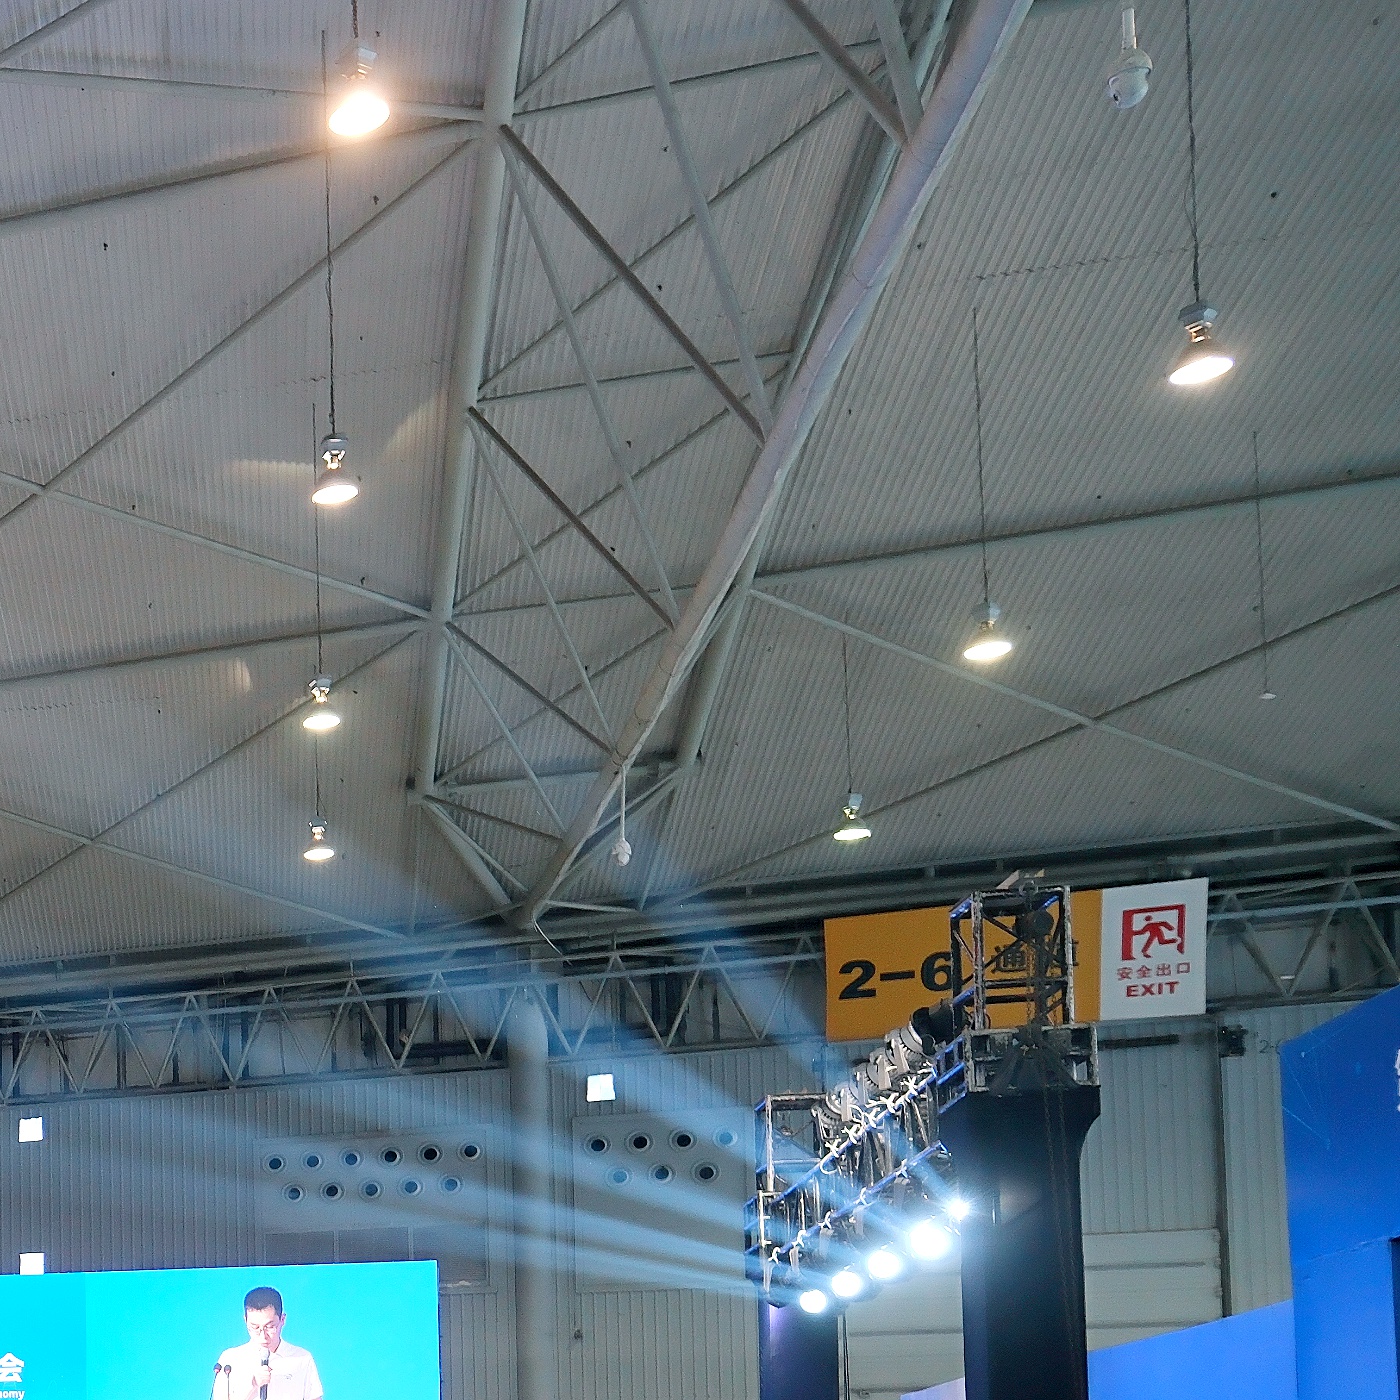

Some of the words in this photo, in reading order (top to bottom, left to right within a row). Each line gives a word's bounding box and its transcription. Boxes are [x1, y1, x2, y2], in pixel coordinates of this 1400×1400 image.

[1116, 961, 1191, 981] 安全出口
[1126, 980, 1180, 998] EXIT
